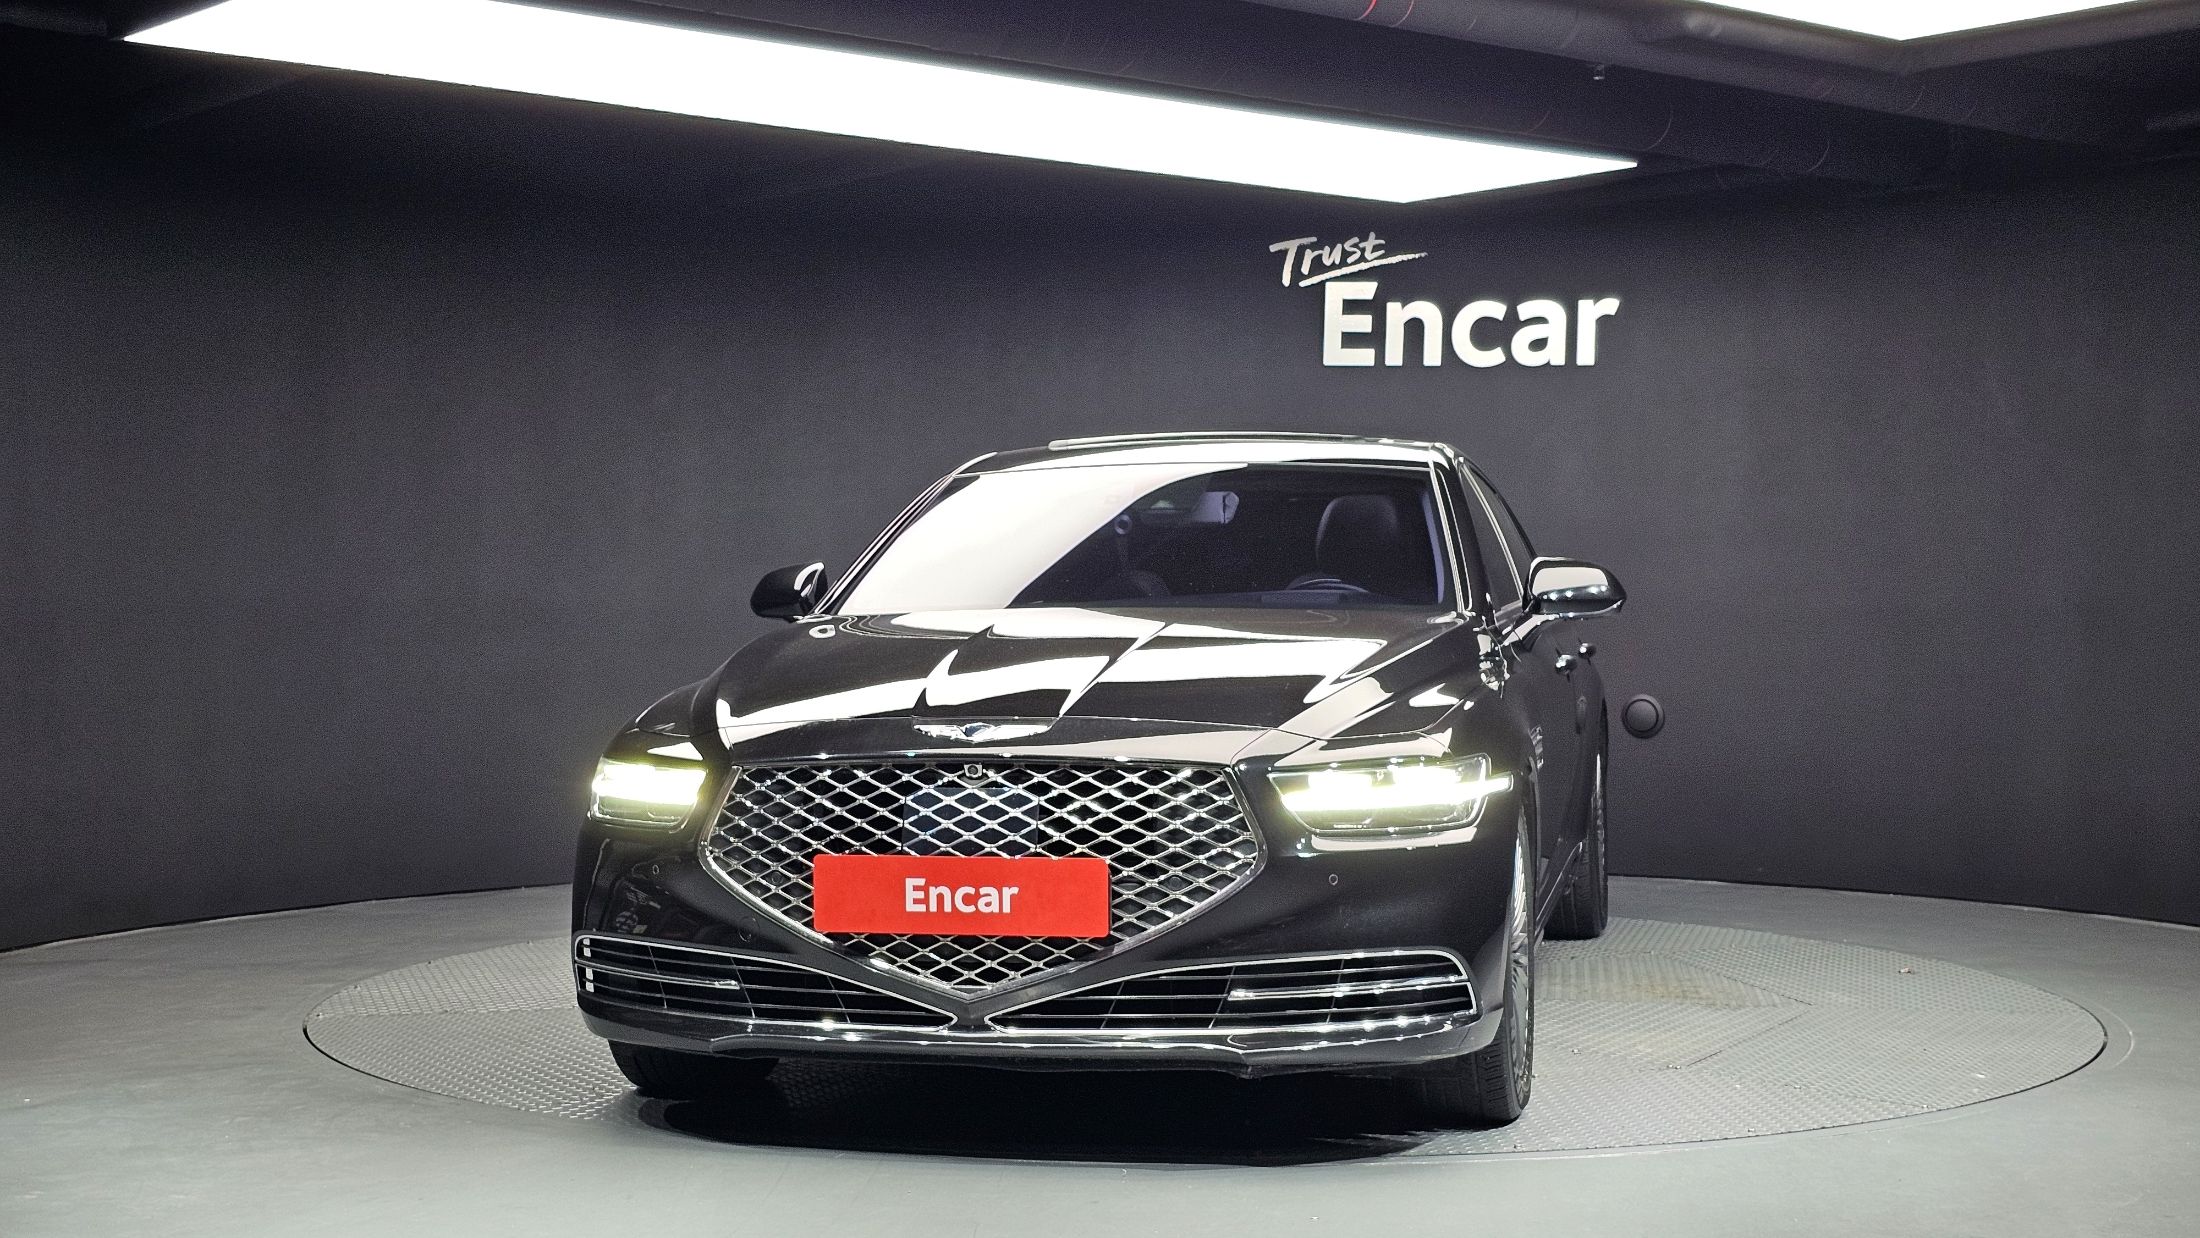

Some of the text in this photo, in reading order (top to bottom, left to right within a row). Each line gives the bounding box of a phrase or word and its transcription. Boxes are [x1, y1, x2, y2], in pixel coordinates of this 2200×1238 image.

[1269, 231, 1386, 288] Trust
[1323, 281, 1621, 368] Encar
[905, 877, 1020, 914] Encar
